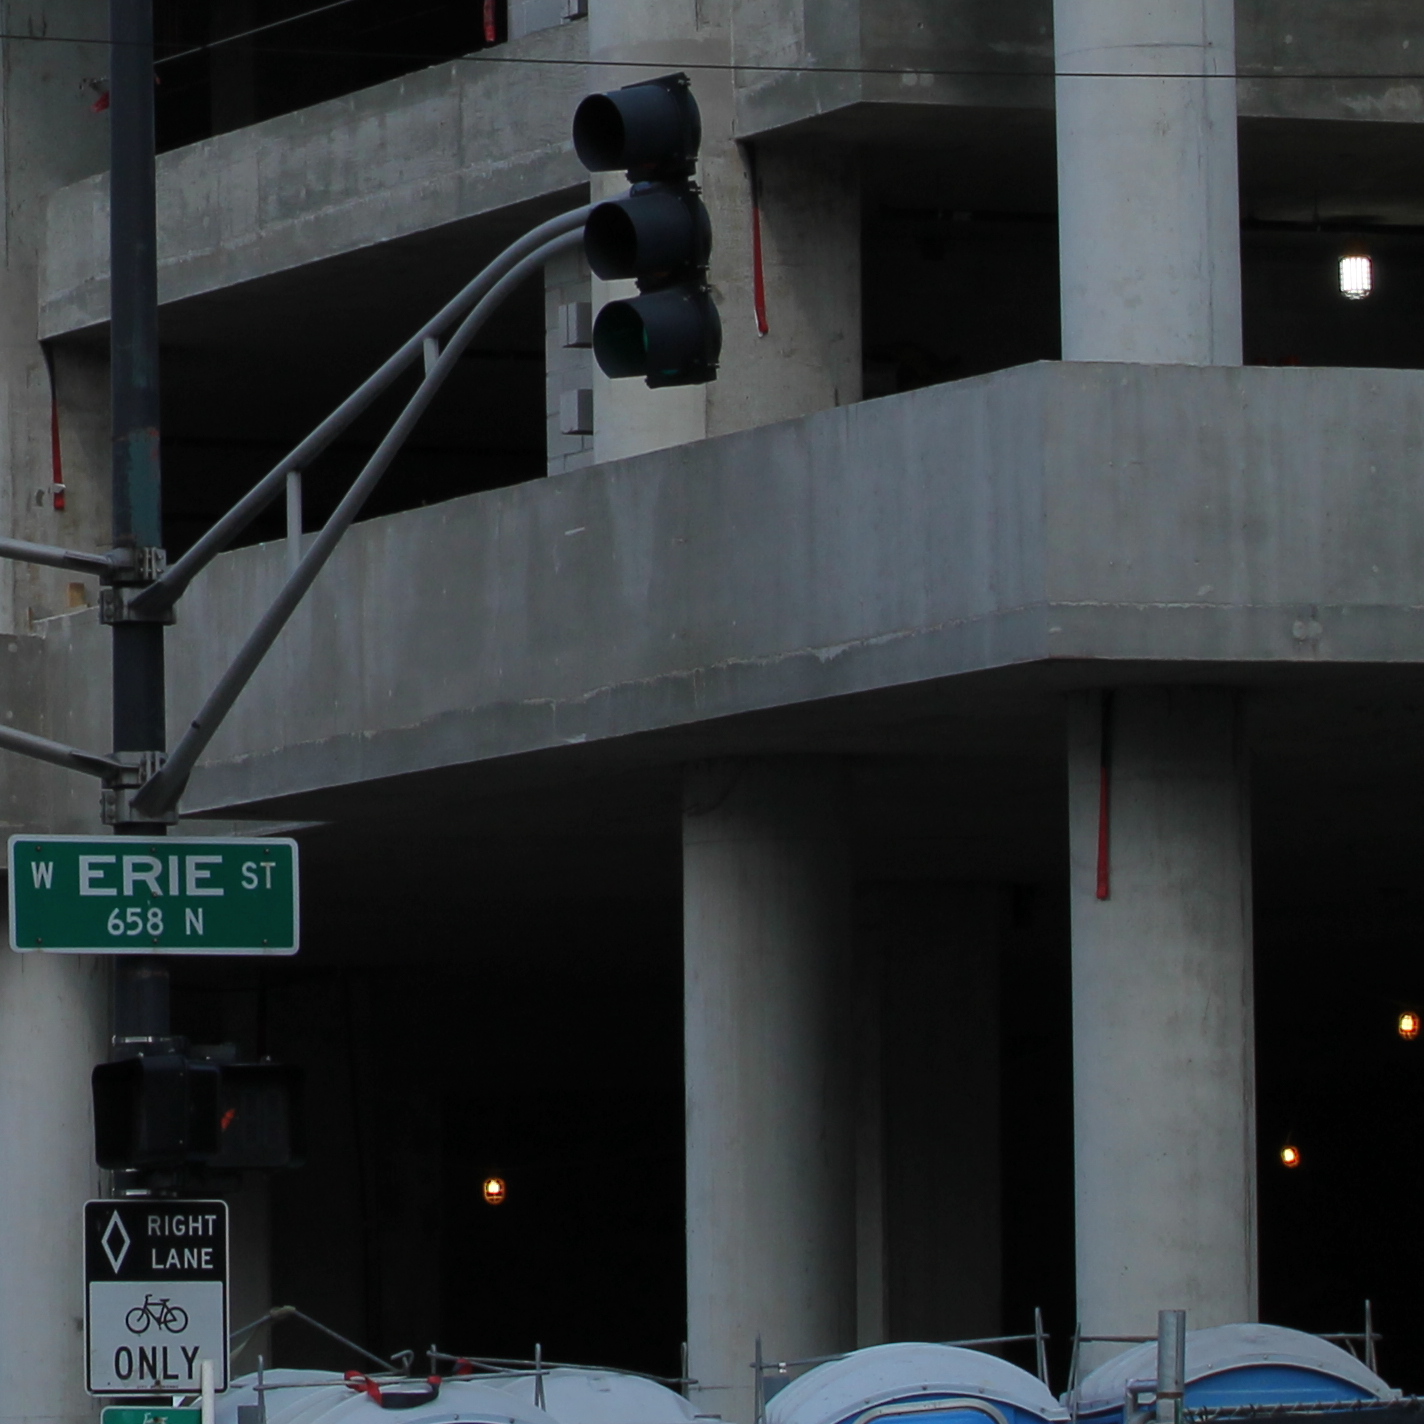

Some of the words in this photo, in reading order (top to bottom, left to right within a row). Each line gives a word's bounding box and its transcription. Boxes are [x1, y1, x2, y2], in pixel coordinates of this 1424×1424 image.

[31, 861, 54, 889] W
[78, 854, 224, 897] ERIE
[241, 861, 277, 889] ST
[107, 907, 164, 936] 658
[185, 908, 204, 936] N
[148, 1215, 217, 1236] RIGHT
[151, 1248, 214, 1269] LANE
[114, 1346, 200, 1381] ONLY
